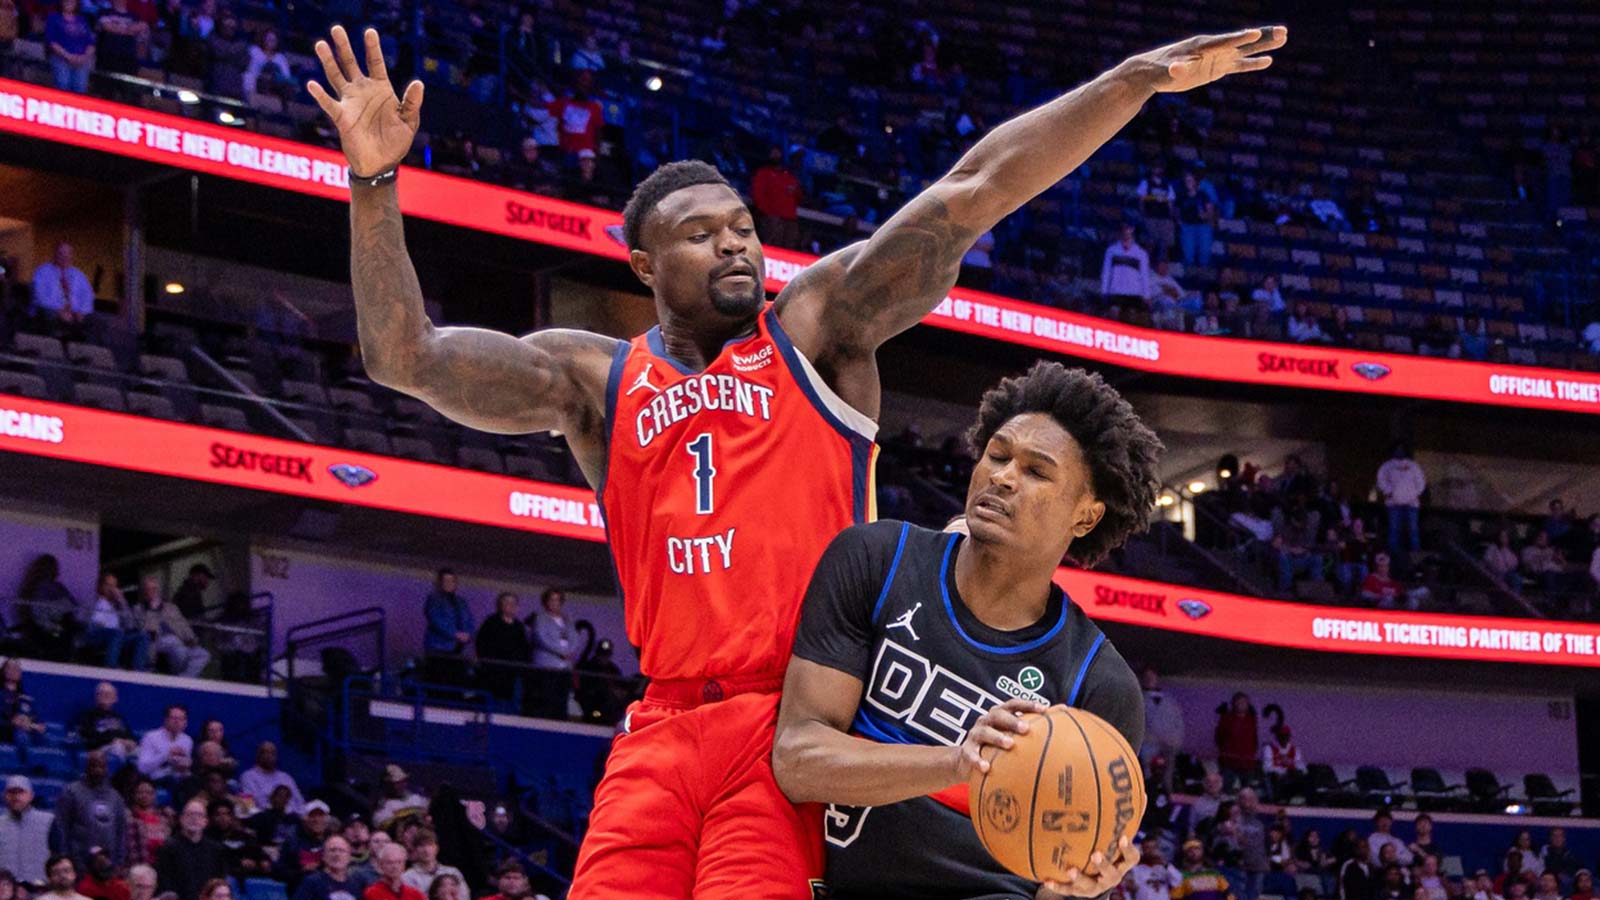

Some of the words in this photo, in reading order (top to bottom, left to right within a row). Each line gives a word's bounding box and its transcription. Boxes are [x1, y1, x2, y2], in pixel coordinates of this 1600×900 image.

[27, 98, 115, 138] PARTNER
[117, 118, 143, 142] OF
[145, 123, 181, 153] THE
[183, 133, 225, 162] NEW
[228, 142, 310, 180] ORLEANS
[506, 201, 592, 240] SEATGEEK
[954, 299, 972, 320] OF
[974, 303, 999, 327] THE
[1001, 310, 1033, 334] NEW
[1033, 317, 1093, 348] ORLEANS
[1094, 330, 1159, 361] PELICANS
[1257, 352, 1340, 379] SEATGEEK
[1490, 374, 1554, 399] OFFICIAL
[636, 374, 774, 447] CRESCENT
[210, 442, 313, 483] SEATGEEK
[686, 433, 717, 515] 1
[510, 491, 588, 526] OFFICIAL
[667, 528, 736, 574] CITY
[1095, 585, 1167, 616] SEATGEEK
[1313, 617, 1382, 643] OFFICIAL
[1383, 622, 1467, 648] TICKETING
[1470, 627, 1540, 652] PARTNER
[1543, 632, 1562, 653] OF
[1565, 633, 1594, 655] THE
